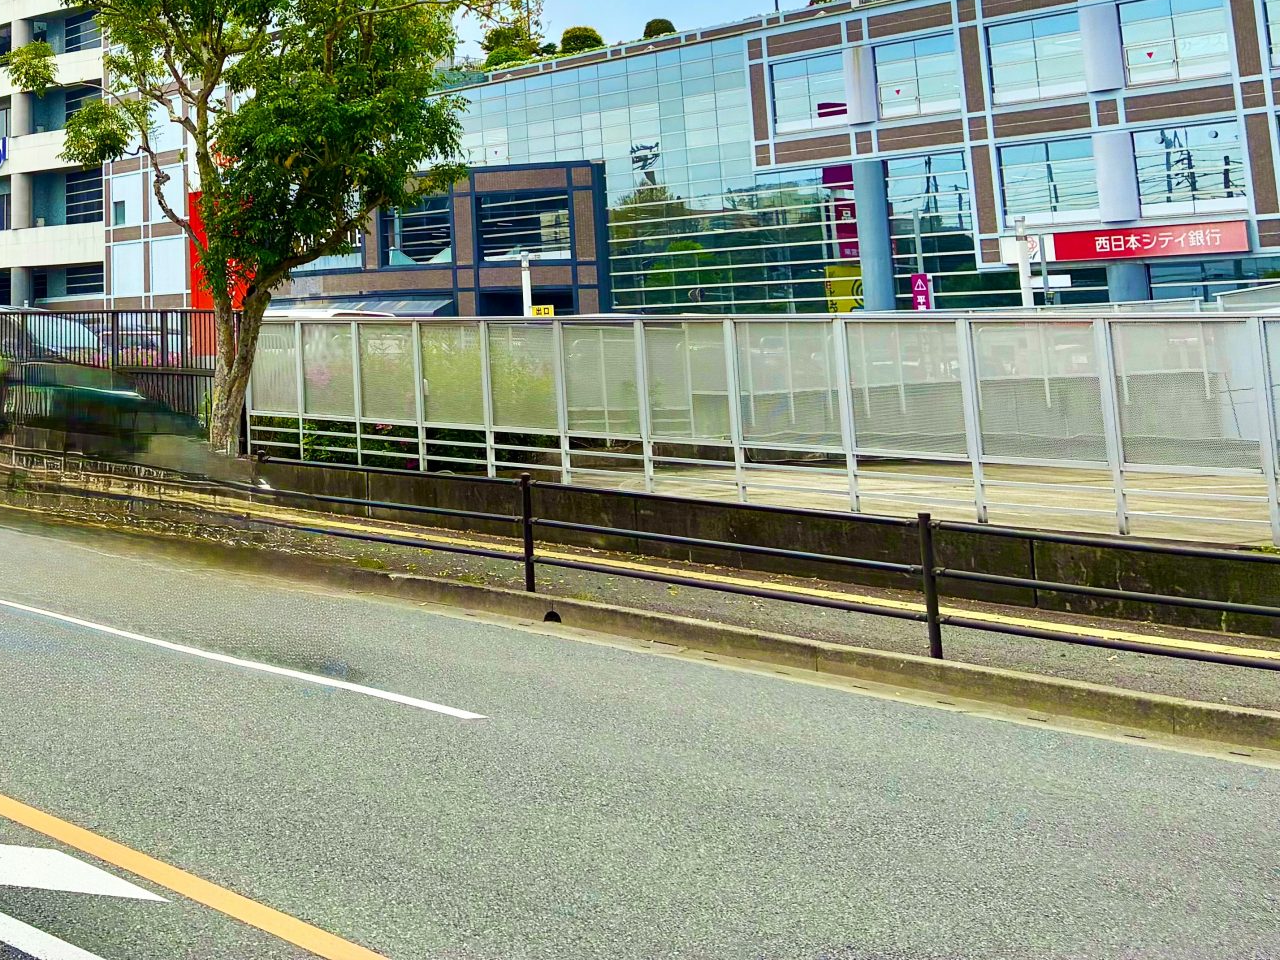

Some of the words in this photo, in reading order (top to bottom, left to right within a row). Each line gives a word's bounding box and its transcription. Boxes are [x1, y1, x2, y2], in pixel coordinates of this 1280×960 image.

[1095, 228, 1222, 253] 西日本シティ銀行
[536, 307, 550, 315] 出口
